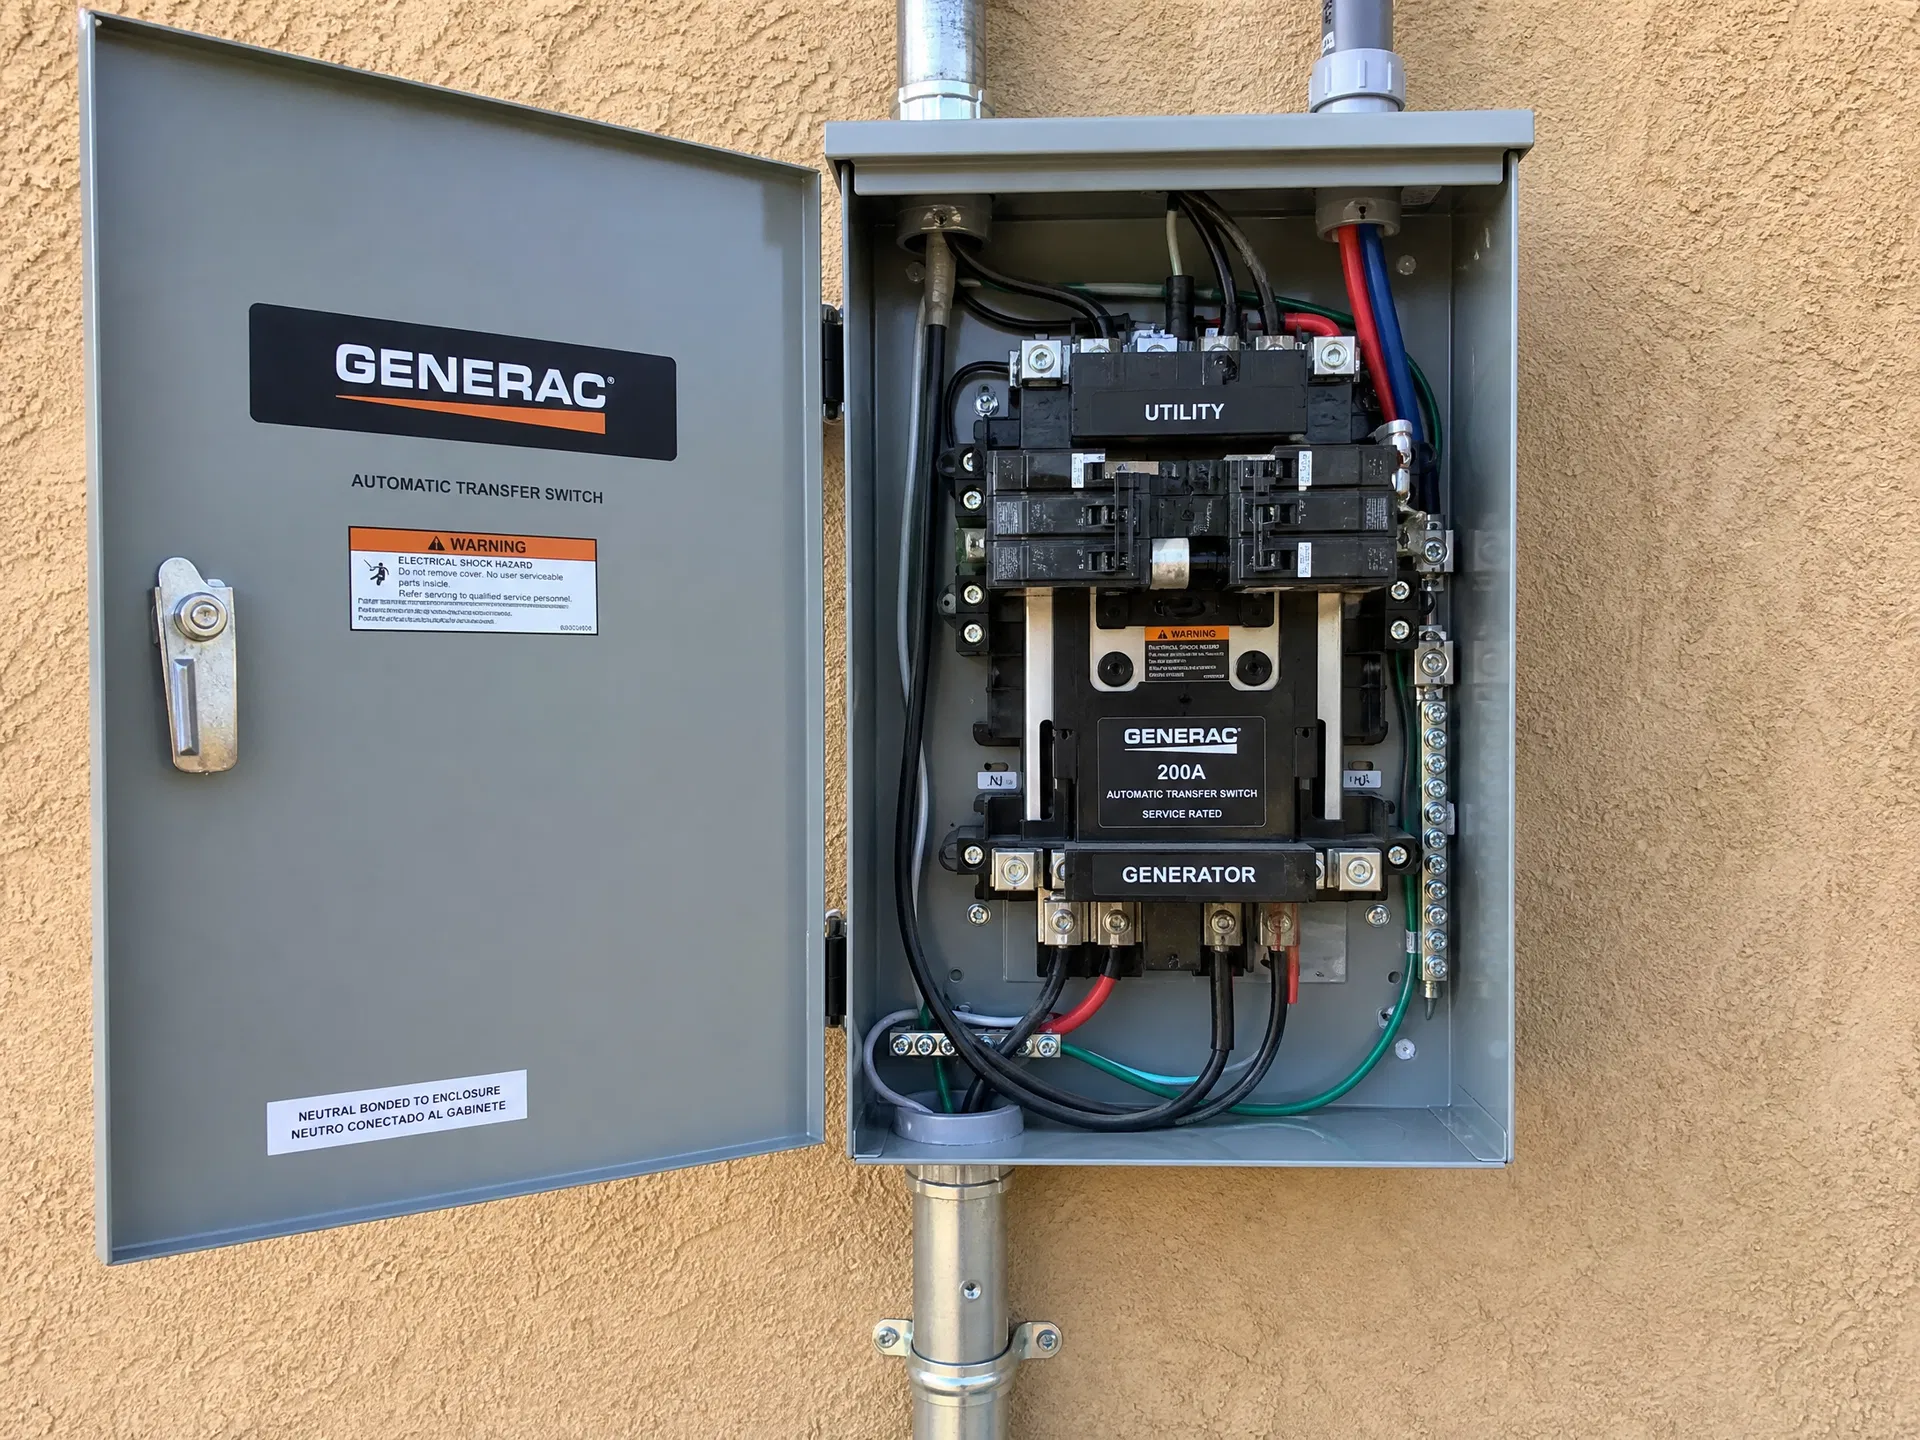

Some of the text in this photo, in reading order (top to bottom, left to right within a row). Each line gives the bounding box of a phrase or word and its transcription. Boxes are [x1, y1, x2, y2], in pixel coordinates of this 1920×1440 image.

[335, 343, 607, 408] GENERAC
[1144, 403, 1225, 421] UTILITY
[351, 474, 604, 504] AUTOMATIC TRANSFER SWITCH
[451, 538, 526, 553] WARNING
[398, 556, 533, 569] ELECTRICAL SHOCK HAZARD
[398, 567, 411, 576] Do
[412, 568, 426, 576] not
[486, 571, 498, 579] No
[520, 573, 564, 581] serviceable
[398, 580, 421, 588] parts
[398, 589, 423, 598] Refer
[1171, 629, 1216, 638] WARNING
[1124, 727, 1238, 744] GENERAC
[1157, 764, 1206, 780] 200A
[1106, 789, 1258, 799] AUTOMATIC TRANSFER SWITCH
[1142, 809, 1222, 819] SERVICE RATED
[1122, 866, 1256, 883] GENERATOR
[298, 1085, 501, 1122] NEUTRAL BONDED TO ENCLOSURE
[291, 1100, 506, 1140] NEUTRO CONECTADO AL GABINETE
